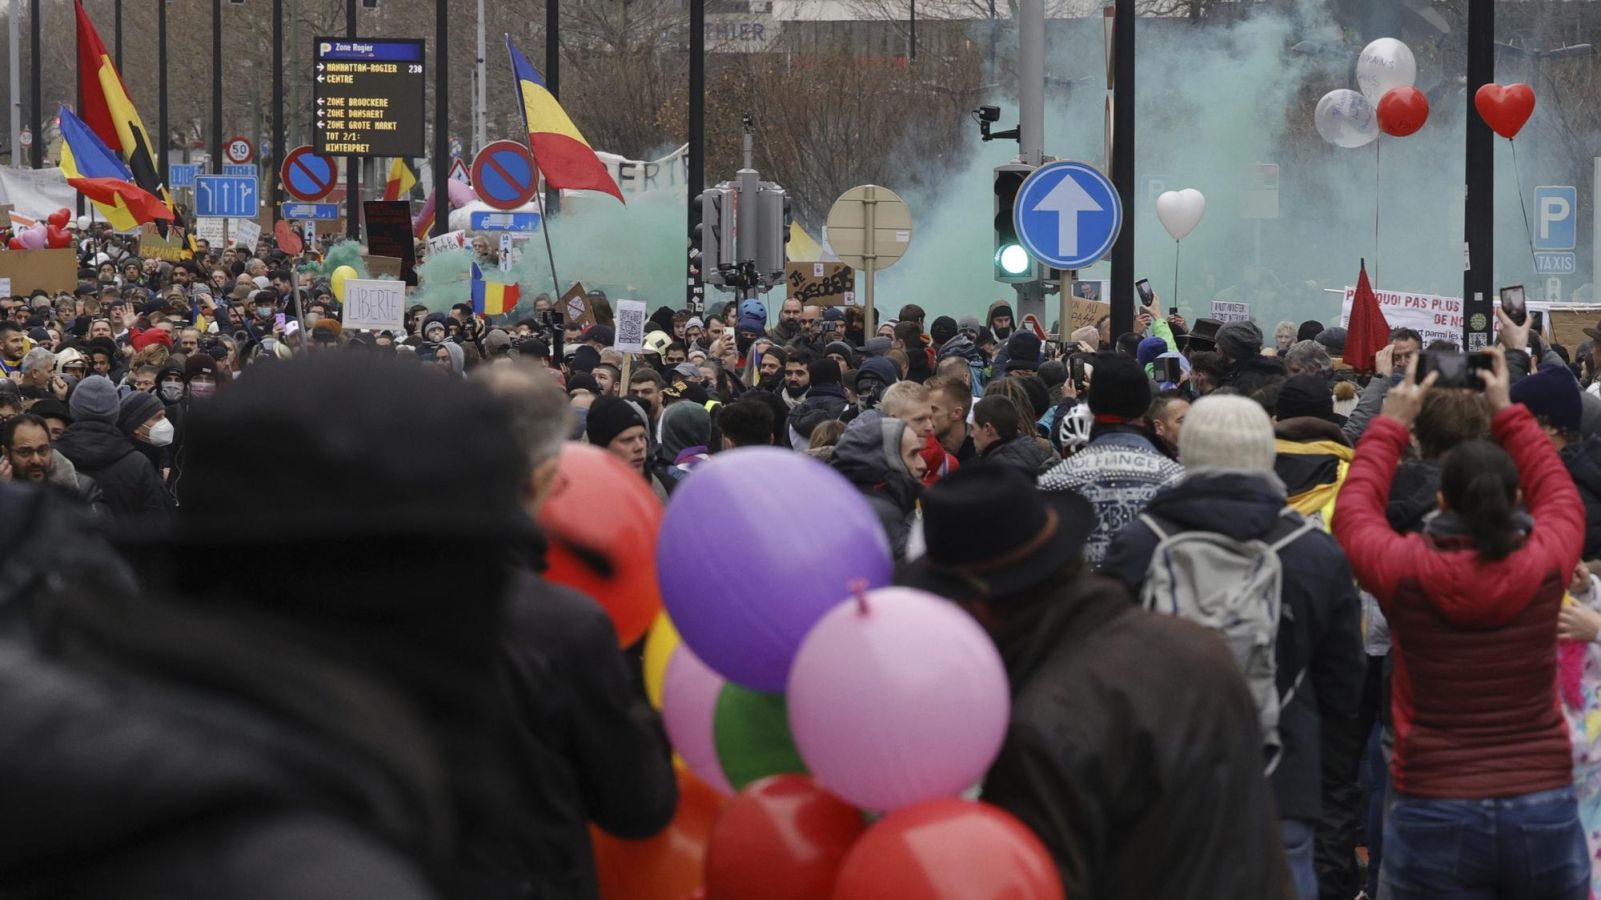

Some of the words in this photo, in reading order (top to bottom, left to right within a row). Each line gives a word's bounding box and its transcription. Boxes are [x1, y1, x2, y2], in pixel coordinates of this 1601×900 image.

[335, 43, 351, 51] Zone
[352, 43, 373, 53] Rogier
[326, 63, 398, 73] MANHATTAN-ROGIER
[408, 64, 423, 74] 238
[326, 74, 354, 84] CENTRE
[326, 97, 345, 106] ZONE
[348, 98, 389, 107] BROUCKERE
[326, 109, 345, 117] ZONE
[348, 109, 384, 118] DANSAERT
[326, 120, 345, 129] ZONE
[348, 121, 371, 130] GROTE
[374, 121, 398, 130] MARKT
[325, 132, 339, 141] TOT
[342, 132, 361, 141] 2/1:
[232, 144, 247, 155] 50
[325, 143, 370, 153] WINTERPRET
[1541, 196, 1570, 240] P
[1537, 256, 1572, 271] TAXIS
[1346, 289, 1401, 306] PQUOI
[1405, 295, 1428, 309] PAS
[1432, 298, 1460, 312] PLUS
[1434, 313, 1448, 326] DE
[1425, 329, 1448, 339] parmi
[1449, 330, 1459, 340] les
